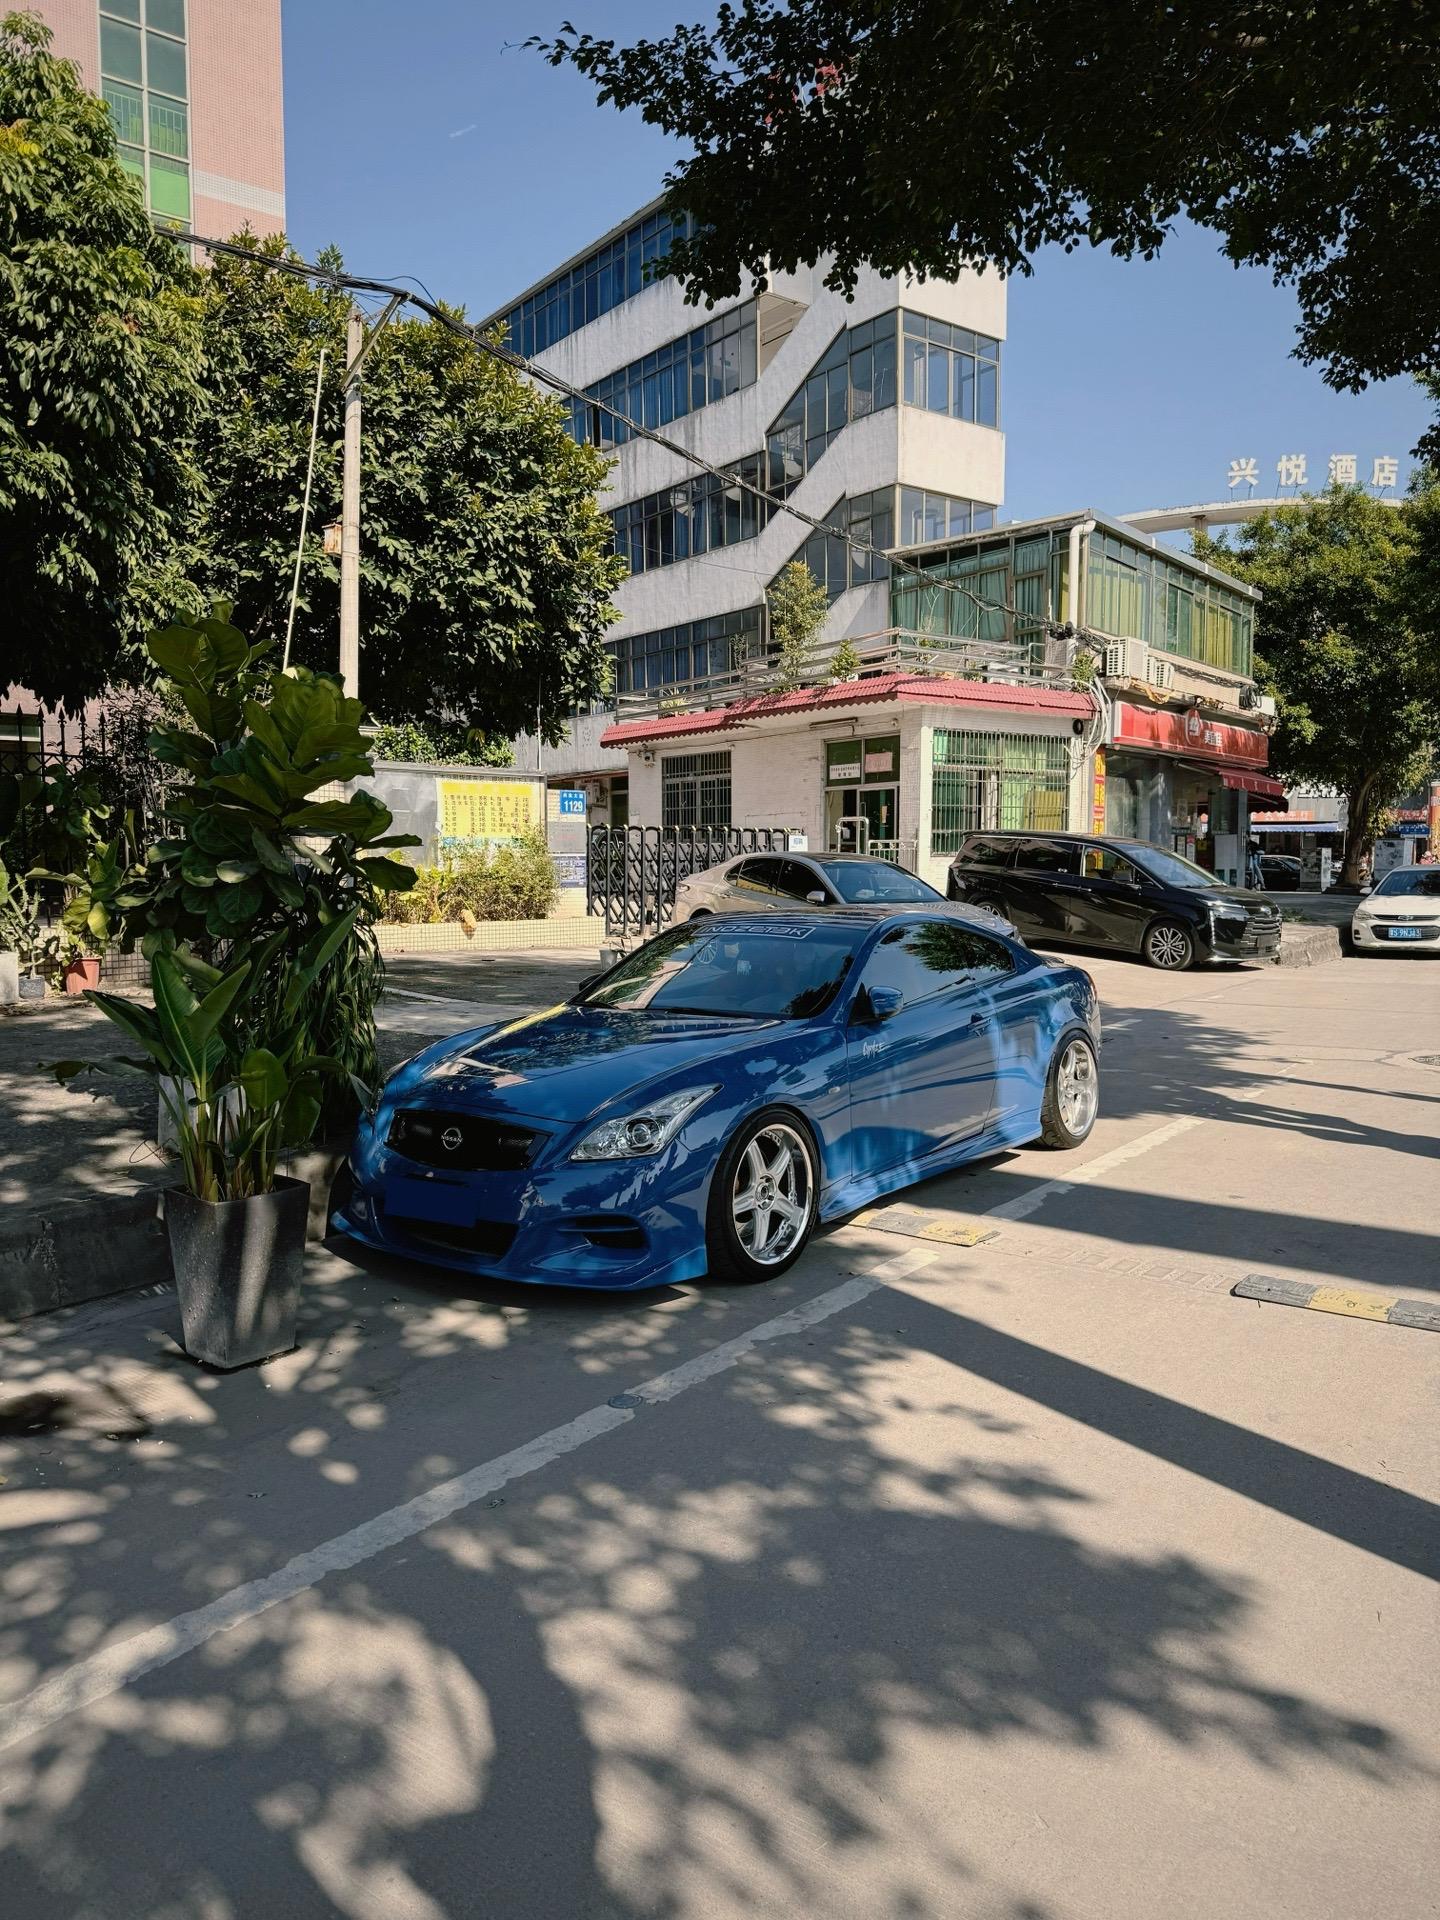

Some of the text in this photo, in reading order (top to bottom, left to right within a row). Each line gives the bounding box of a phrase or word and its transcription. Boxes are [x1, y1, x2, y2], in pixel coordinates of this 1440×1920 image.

[1227, 453, 1399, 488] 兴悦酒店
[563, 800, 584, 812] 1129
[440, 1134, 464, 1144] NISSAN
